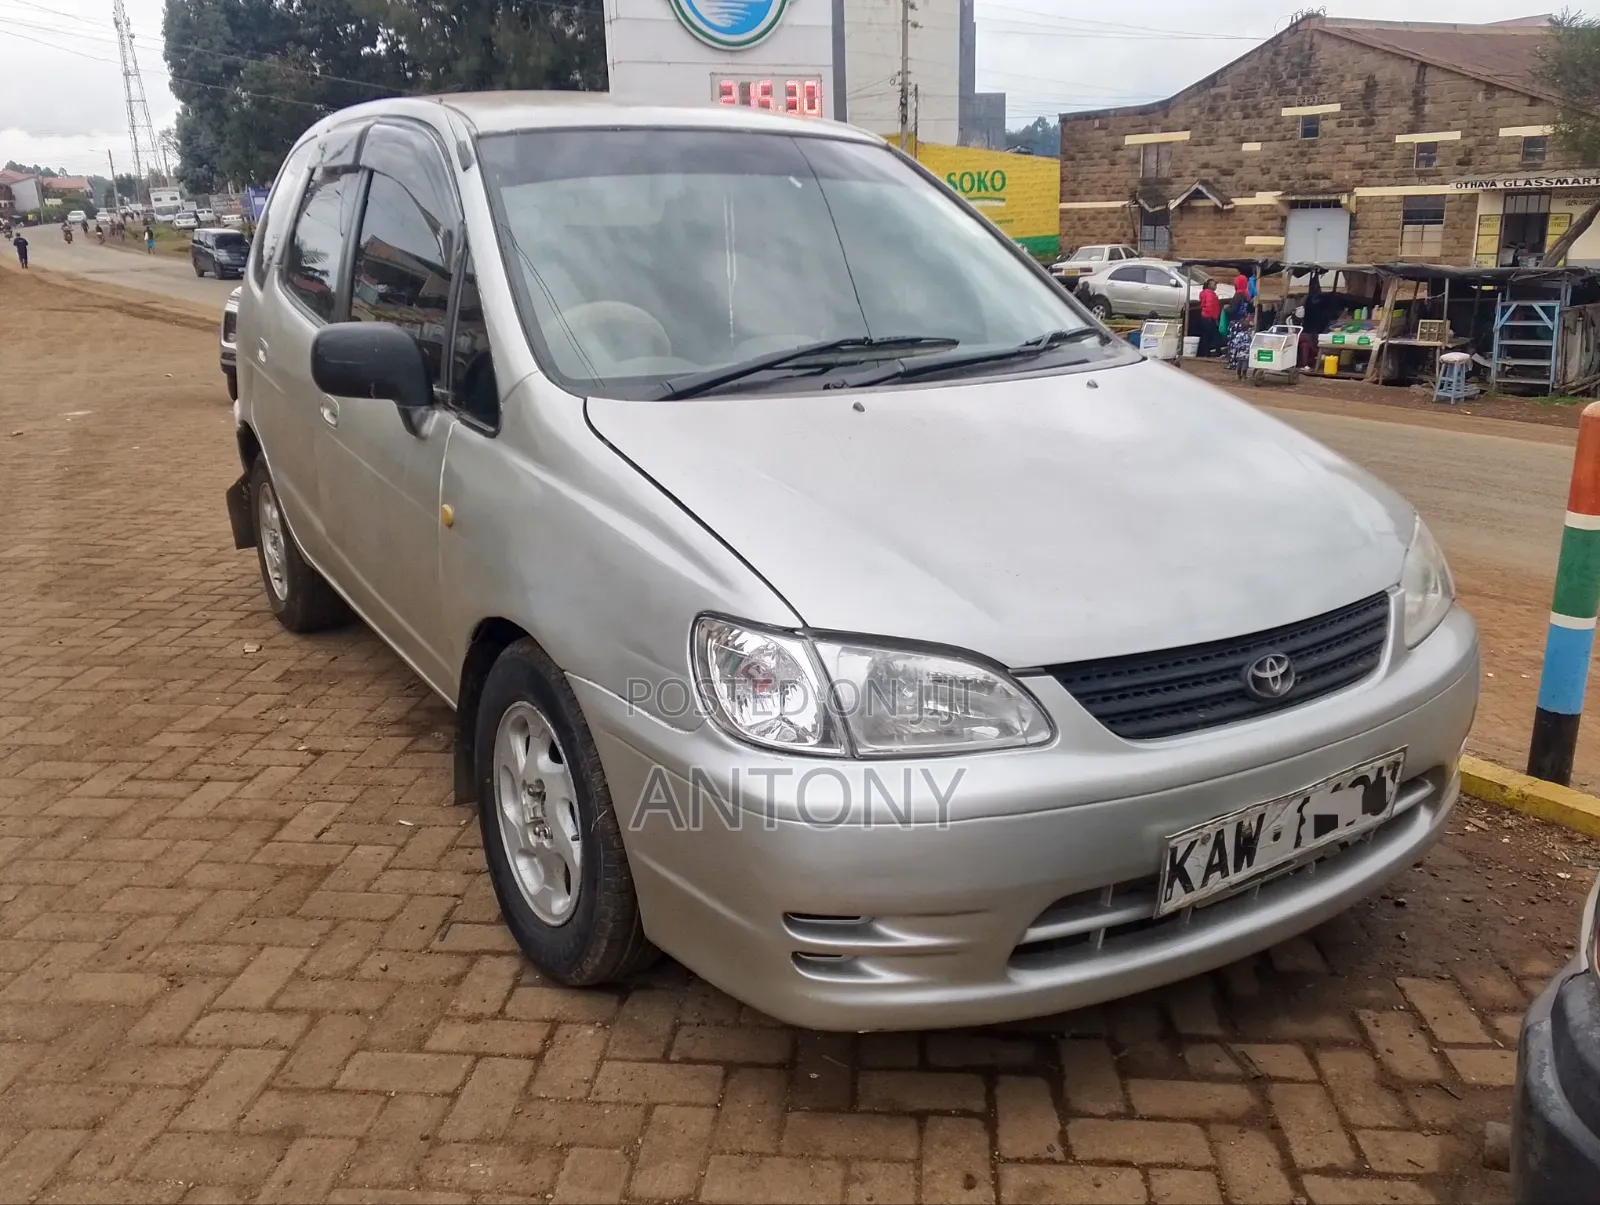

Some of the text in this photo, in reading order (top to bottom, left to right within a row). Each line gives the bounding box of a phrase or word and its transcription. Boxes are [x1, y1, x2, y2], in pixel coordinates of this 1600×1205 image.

[946, 169, 1007, 194] SOKO
[1455, 177, 1600, 189] OTHAYA GLASSMART
[1163, 812, 1266, 904] KAW
